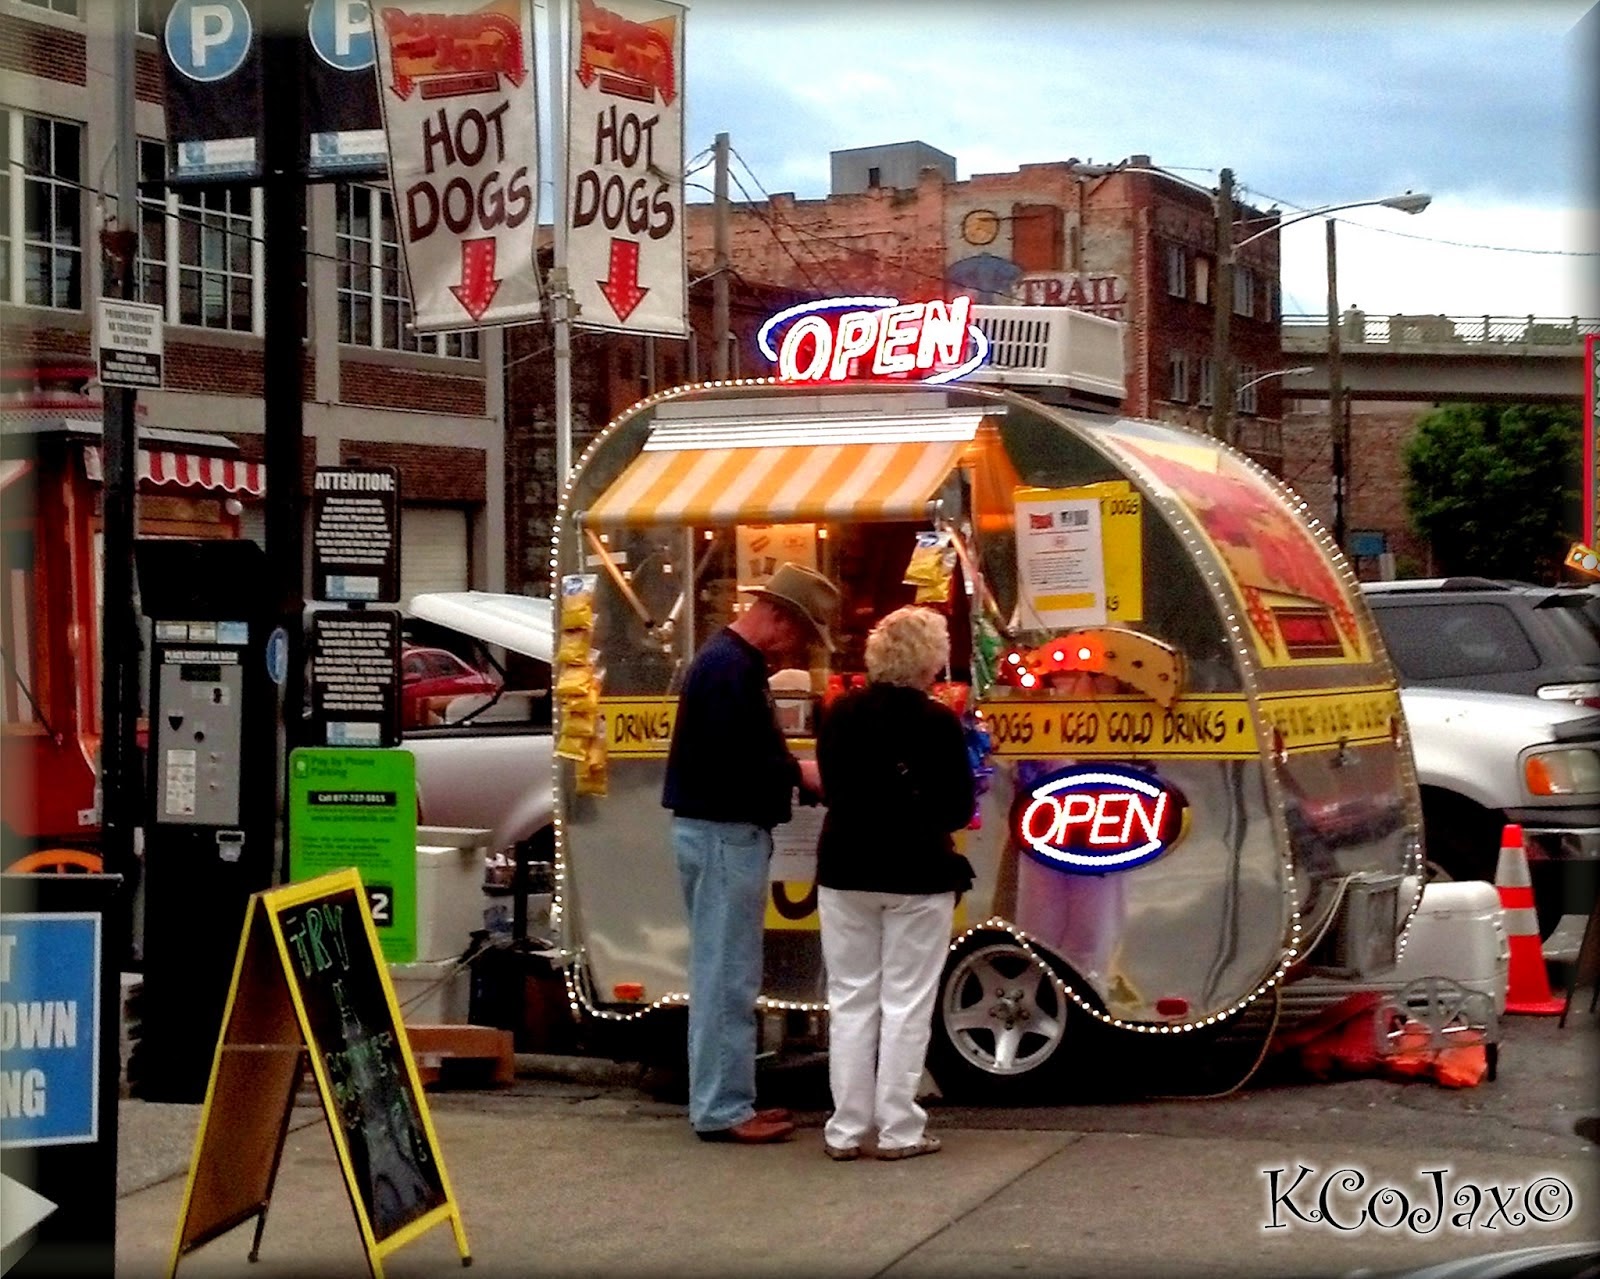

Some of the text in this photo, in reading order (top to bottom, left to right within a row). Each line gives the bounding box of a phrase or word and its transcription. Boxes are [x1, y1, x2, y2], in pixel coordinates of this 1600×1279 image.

[190, 4, 234, 67] P
[422, 100, 509, 174] HOT
[594, 105, 659, 171] HOT
[407, 166, 532, 242] DOGS
[573, 169, 674, 239] DOGS
[1017, 276, 1127, 306] TRAIL
[779, 296, 970, 381] OPEN
[315, 472, 395, 491] ATTENTION:
[614, 711, 669, 743] DRINKS
[987, 712, 1033, 744] DOGS
[1060, 711, 1099, 744] ICED
[1162, 709, 1227, 744] DRINKS
[1021, 791, 1167, 845] OPEN
[371, 892, 389, 920] 2
